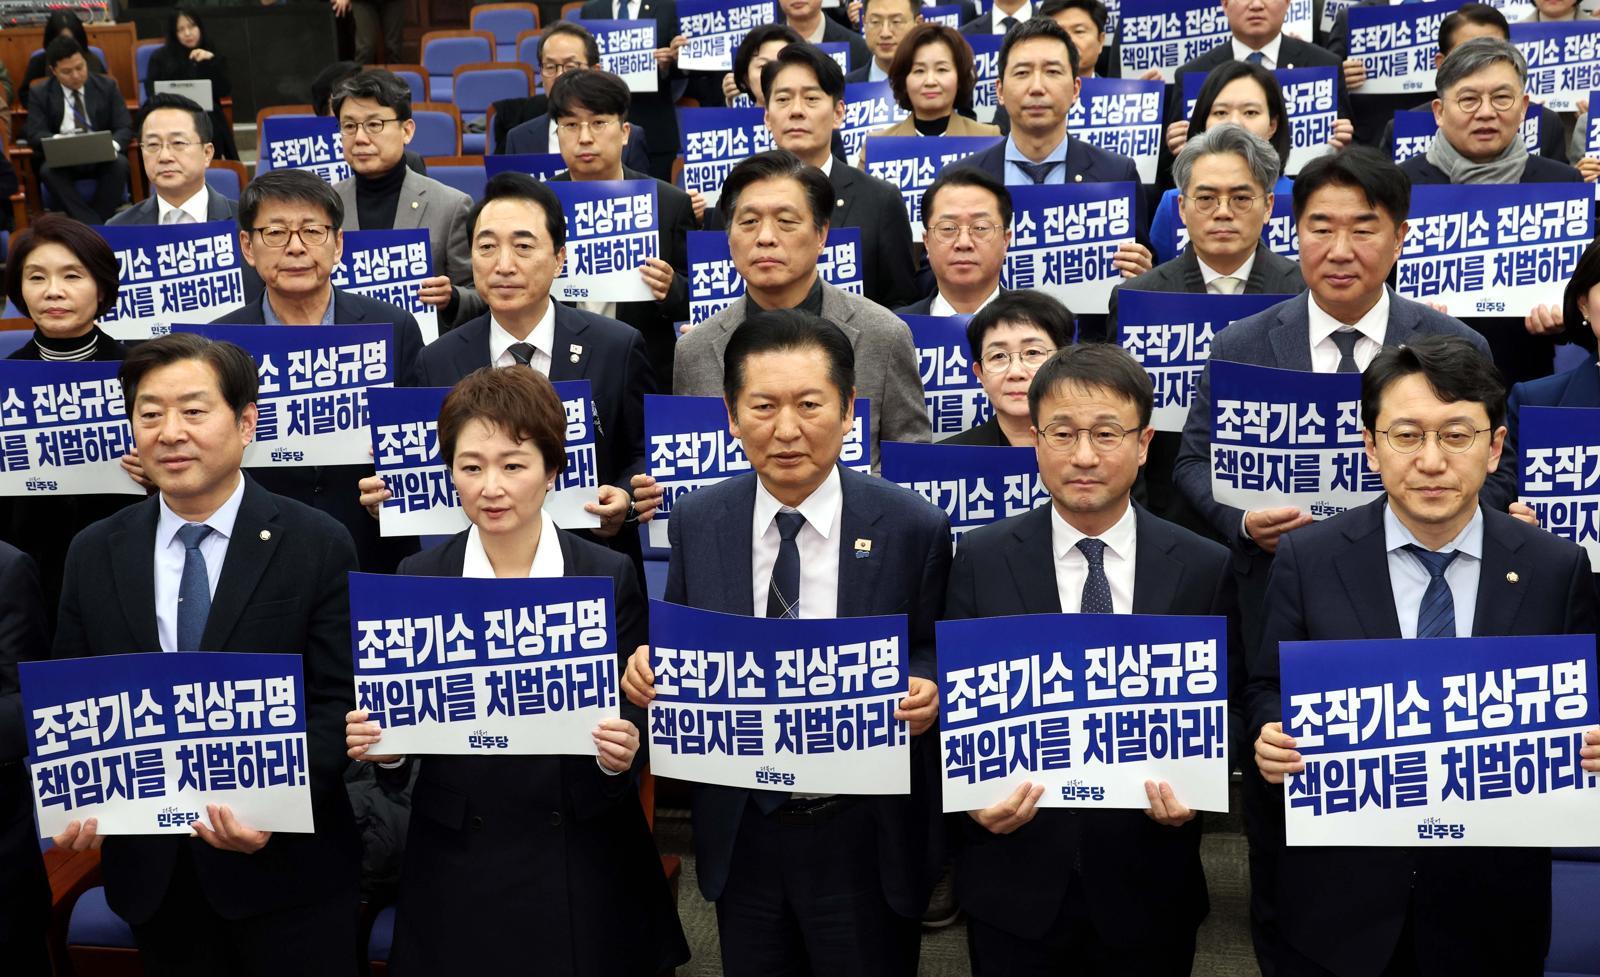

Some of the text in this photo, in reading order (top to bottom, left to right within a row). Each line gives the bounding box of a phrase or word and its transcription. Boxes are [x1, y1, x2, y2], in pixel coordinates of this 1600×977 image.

[608, 26, 654, 53] 진상규명
[680, 2, 775, 37] 조작기소 진상규명
[1122, 12, 1181, 42] 조작기소
[1185, 5, 1229, 36] 진상규
[1350, 21, 1412, 54] 조작기소
[1122, 43, 1179, 70] 책임자를
[1364, 52, 1408, 79] 임자를
[1282, 78, 1334, 115] 상규명
[1525, 69, 1555, 95] 자를
[1091, 92, 1160, 126] 진상규명
[270, 137, 331, 168] 조작기소
[686, 127, 749, 161] 조작기소
[574, 193, 653, 236] 진상규명
[1043, 197, 1130, 243] 진상규명
[1403, 198, 1589, 256] 조작기소 진상규명
[114, 233, 235, 281] 기소 진상규명
[352, 241, 428, 284] 진상규명
[1399, 255, 1485, 298] 책임자를
[103, 272, 242, 322] 자를 처벌하라!
[564, 288, 589, 297] 민주당
[1476, 302, 1505, 312] 민주당
[287, 339, 387, 391] 진상규명
[915, 345, 968, 386] 기소
[32, 377, 126, 424] 진상규명
[1216, 400, 1326, 444] 조작기소
[271, 451, 304, 462] 민주당
[1214, 448, 1321, 493] 책임자를
[26, 481, 58, 491] 민주당
[382, 469, 462, 514] 책임자
[357, 598, 608, 670] 조작기소 진상규명
[654, 635, 899, 699] 조작기소 진상규명
[946, 638, 1218, 724] 조작기소 진상규명
[358, 659, 616, 729] 책임자를 처벌하라!
[1290, 658, 1588, 749] 조작기소 진상규명
[32, 675, 297, 757] 조작기소 진상규명
[651, 705, 764, 756] 책임자를
[468, 735, 509, 749] 민주당
[945, 705, 1224, 785] 책임자를 처벌하라!
[37, 738, 306, 812] 책임자를 처벌하라!
[755, 770, 796, 786] 민주당
[1061, 785, 1105, 801] 민주당
[1288, 750, 1428, 816] 책임자를
[157, 812, 200, 827] 민주당
[1417, 824, 1465, 839] 민주당
